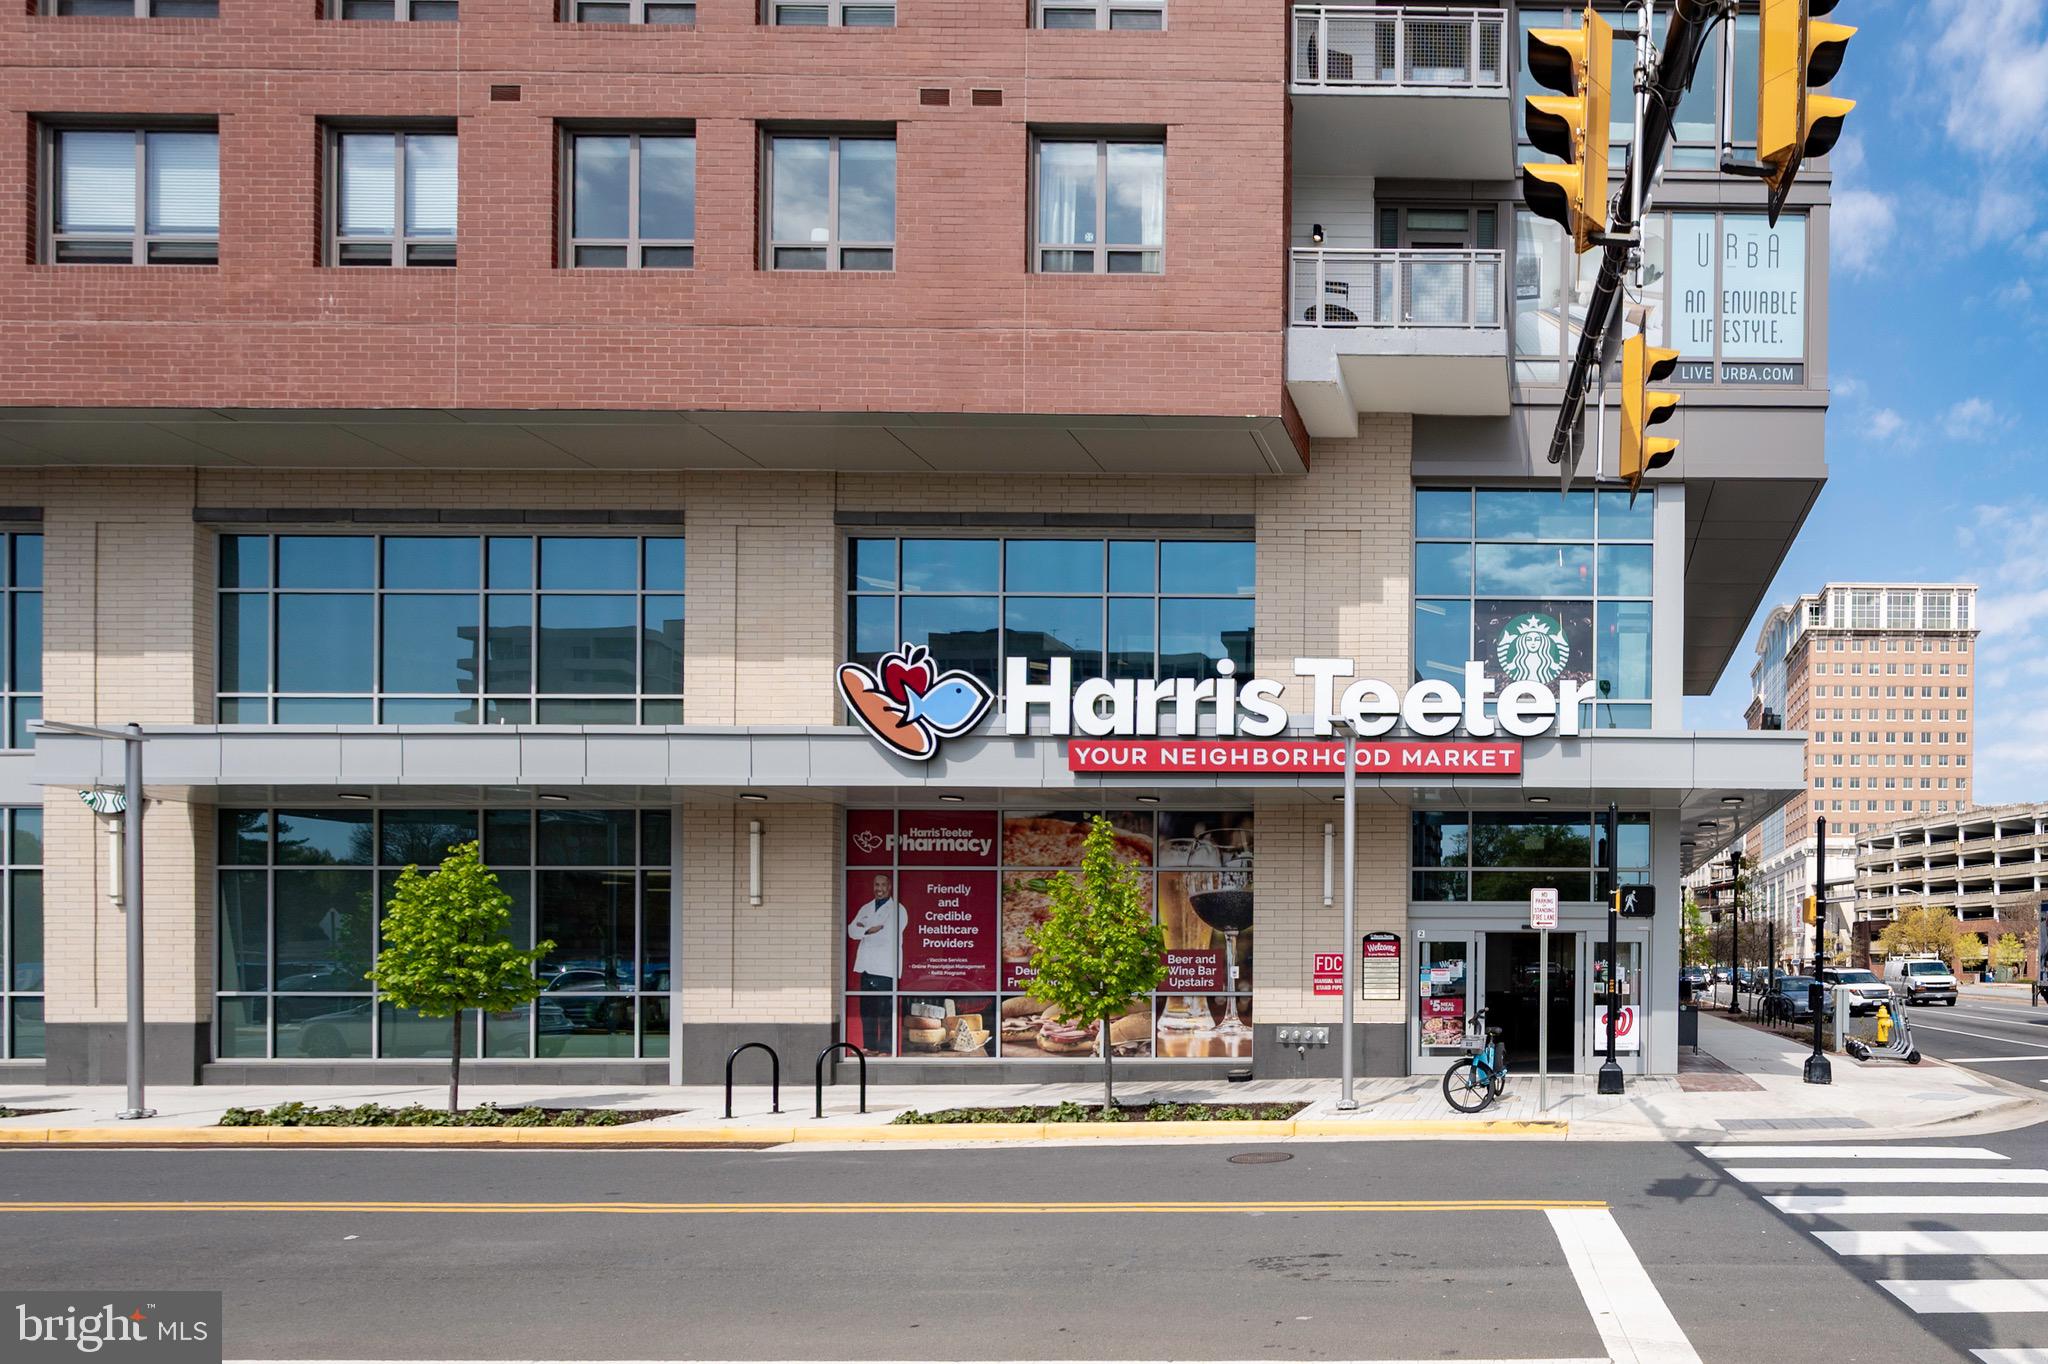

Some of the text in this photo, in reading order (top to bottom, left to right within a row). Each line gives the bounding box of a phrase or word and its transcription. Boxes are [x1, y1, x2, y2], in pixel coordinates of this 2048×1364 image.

[1697, 232, 1780, 269] URBA
[1685, 289, 1797, 315] AN ENVIABLE
[1005, 656, 1597, 738] Harris Teeter
[1075, 747, 1147, 765] YOUR
[1402, 749, 1515, 767] MARKET
[909, 828, 973, 837] Harris Teeter
[885, 834, 992, 856] Pharmacy
[927, 884, 971, 896] Friendly
[938, 898, 959, 907] and
[925, 911, 972, 920] Credible
[918, 924, 979, 934] Healthcare
[922, 938, 974, 948] Providers
[1367, 942, 1397, 952] Welcome
[1167, 953, 1216, 964] Beer and
[1316, 956, 1342, 971] FDC
[1168, 965, 1216, 976] Wine Bar
[1169, 977, 1214, 989] Upstairs
